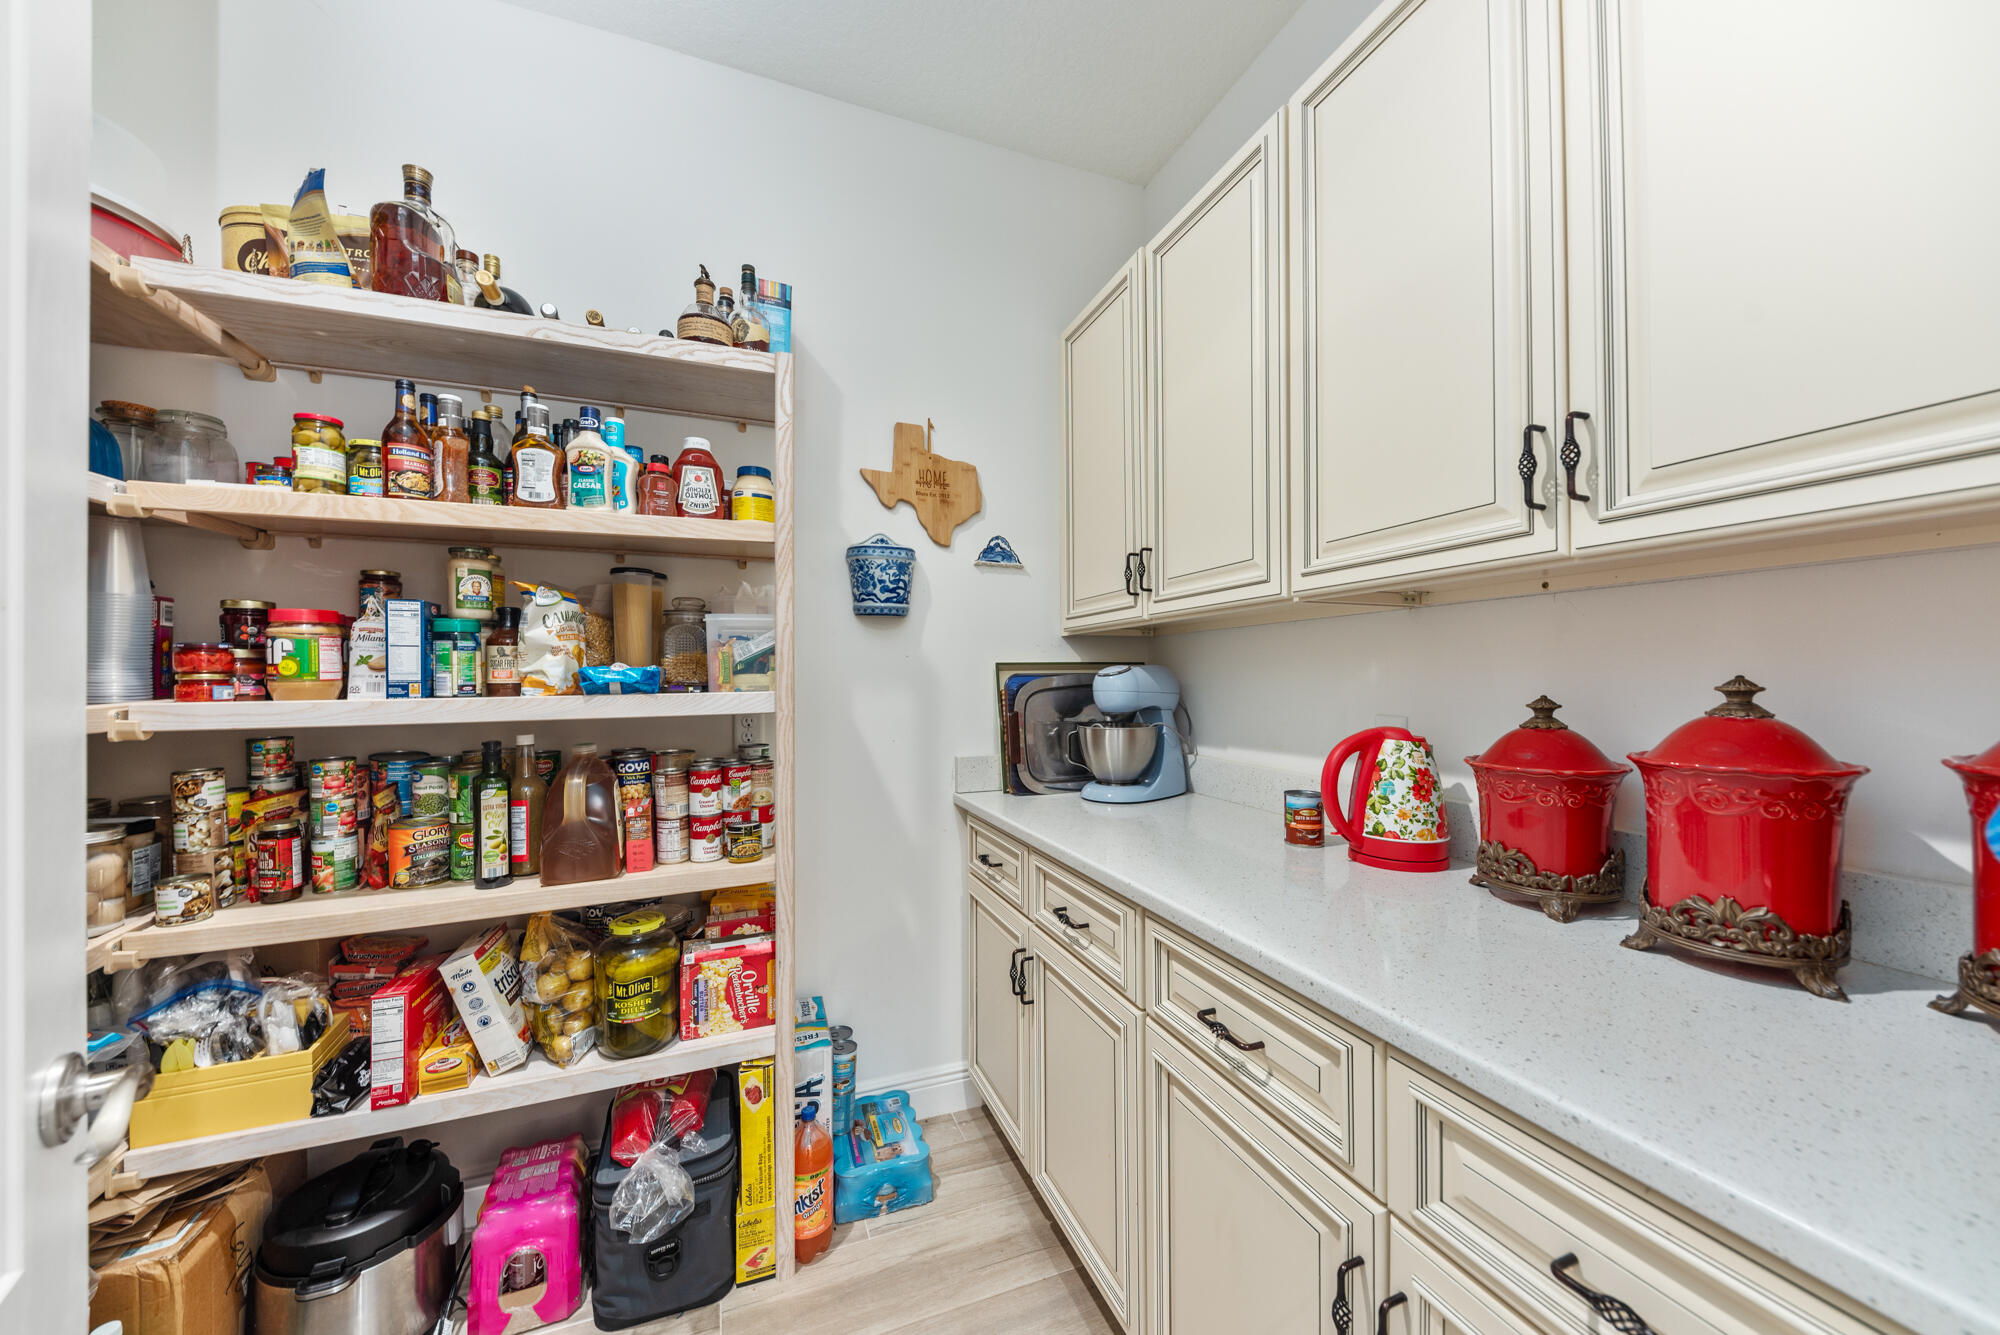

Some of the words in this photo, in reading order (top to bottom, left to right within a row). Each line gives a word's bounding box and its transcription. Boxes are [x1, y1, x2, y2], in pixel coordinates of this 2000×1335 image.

[392, 448, 420, 456] Holland
[918, 468, 948, 490] HOME
[573, 481, 602, 489] CAESAR
[686, 486, 711, 494] KETCHUP
[684, 491, 712, 500] TOMATO
[689, 501, 710, 509] HEINZ
[355, 633, 386, 643] Milano
[490, 659, 504, 668] SUGAR
[503, 659, 515, 668] FREE
[618, 761, 650, 773] GOYA
[412, 826, 449, 842] GLORY
[616, 985, 628, 998] Mt.
[628, 981, 650, 996] Olive
[728, 963, 750, 1024] Redenbacher's
[740, 970, 761, 1014] Orville
[615, 997, 652, 1009] KOSHER
[620, 1006, 646, 1015] DILLS
[802, 1199, 823, 1219] Orange
